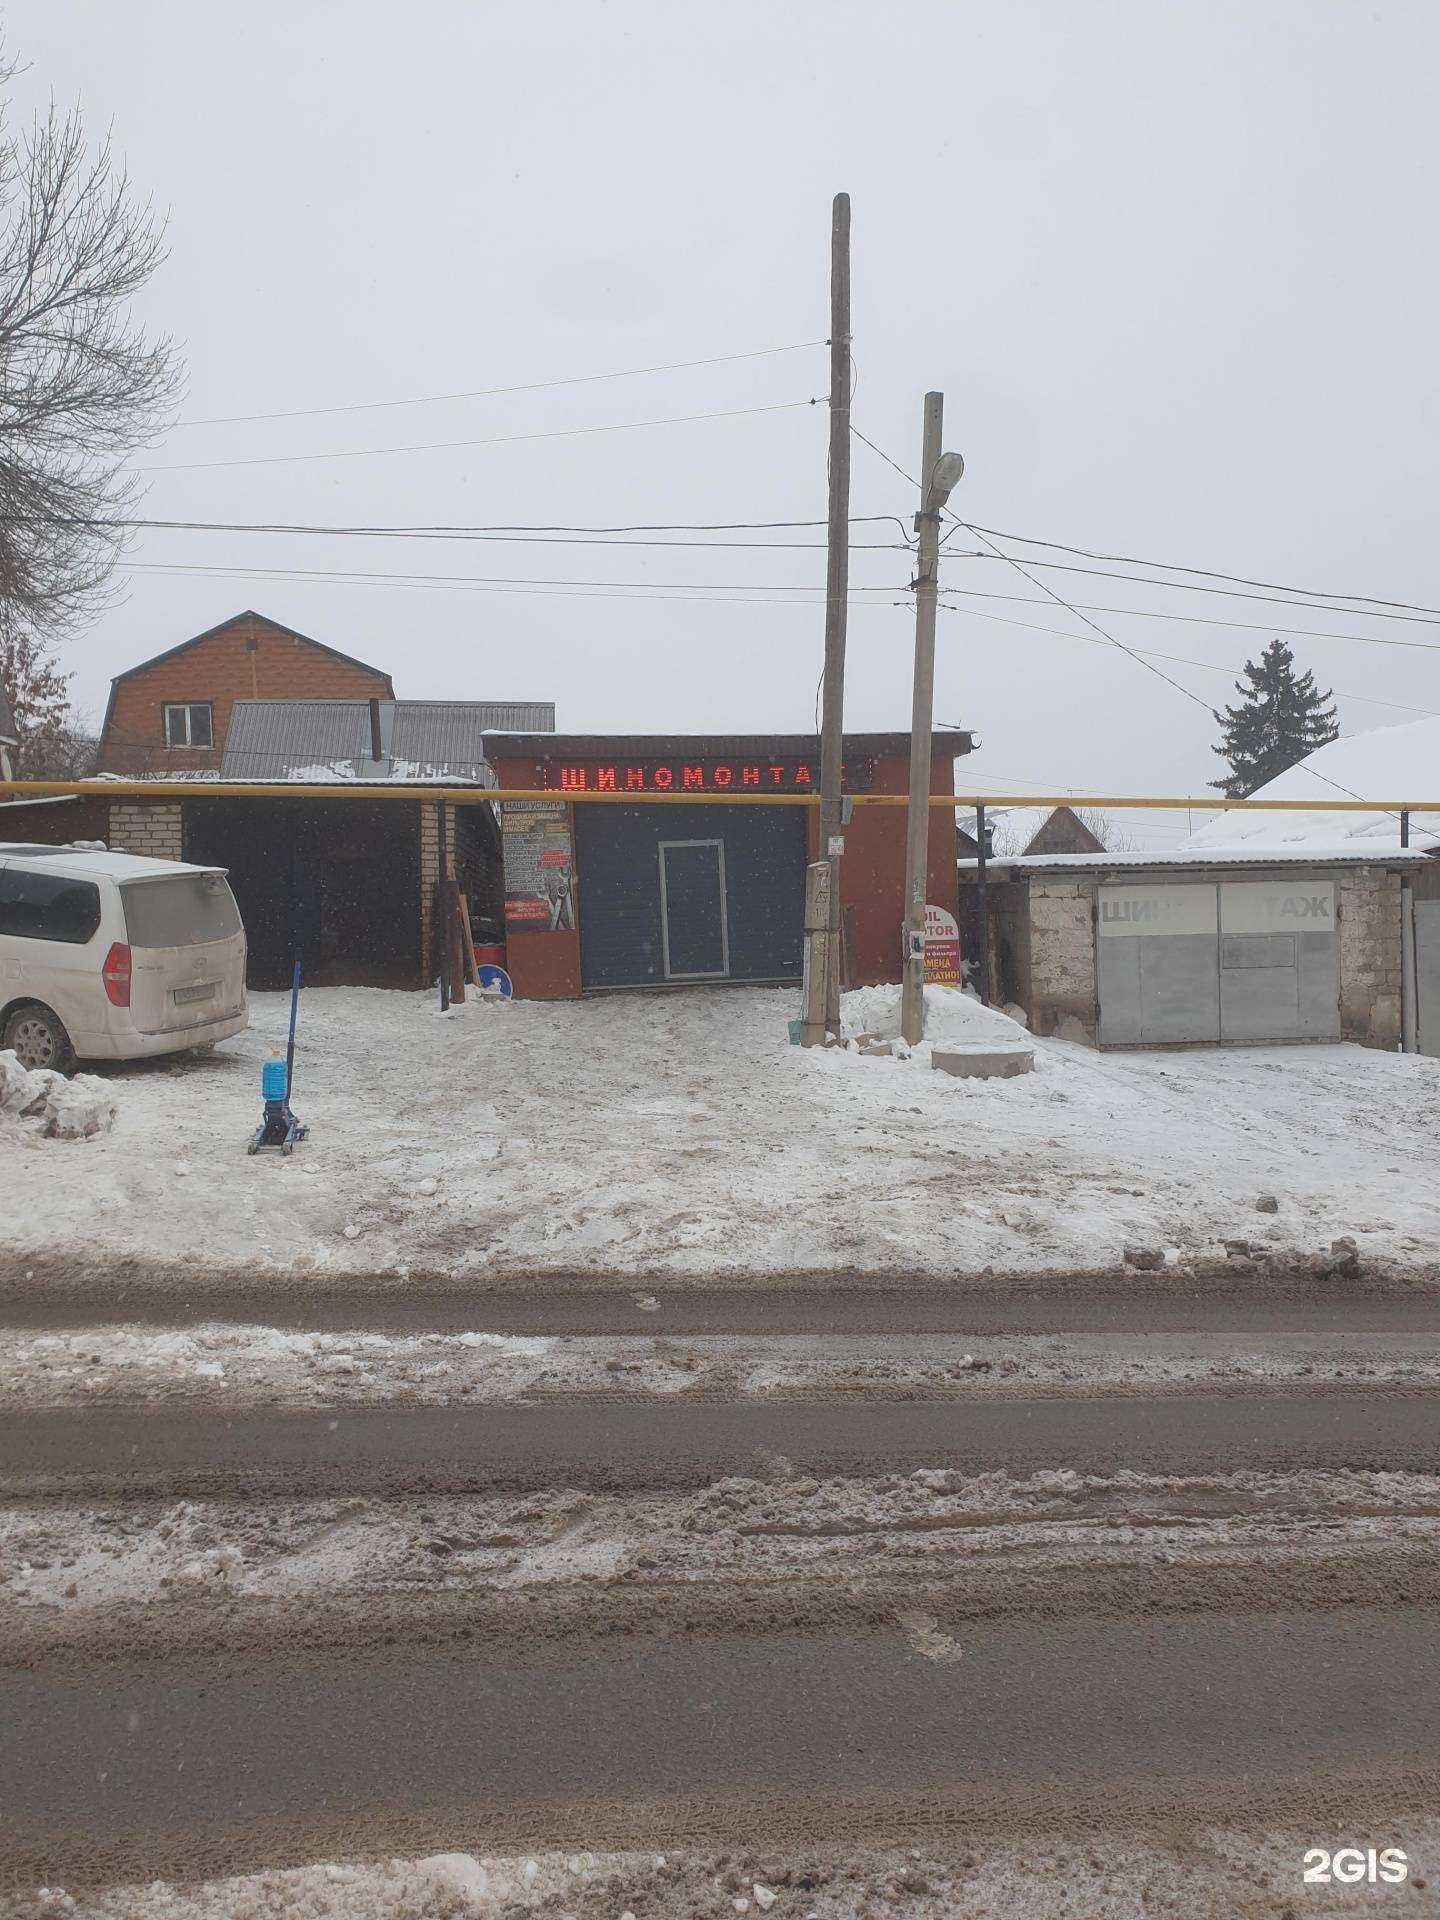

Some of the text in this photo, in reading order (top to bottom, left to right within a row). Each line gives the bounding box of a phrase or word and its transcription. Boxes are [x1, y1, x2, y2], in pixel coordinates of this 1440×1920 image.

[562, 767, 846, 788] ШИНОМОНТА
[506, 801, 561, 810] НАШИ УСЛУГИ
[926, 925, 954, 936] TOR
[924, 959, 951, 968] АМЕНА
